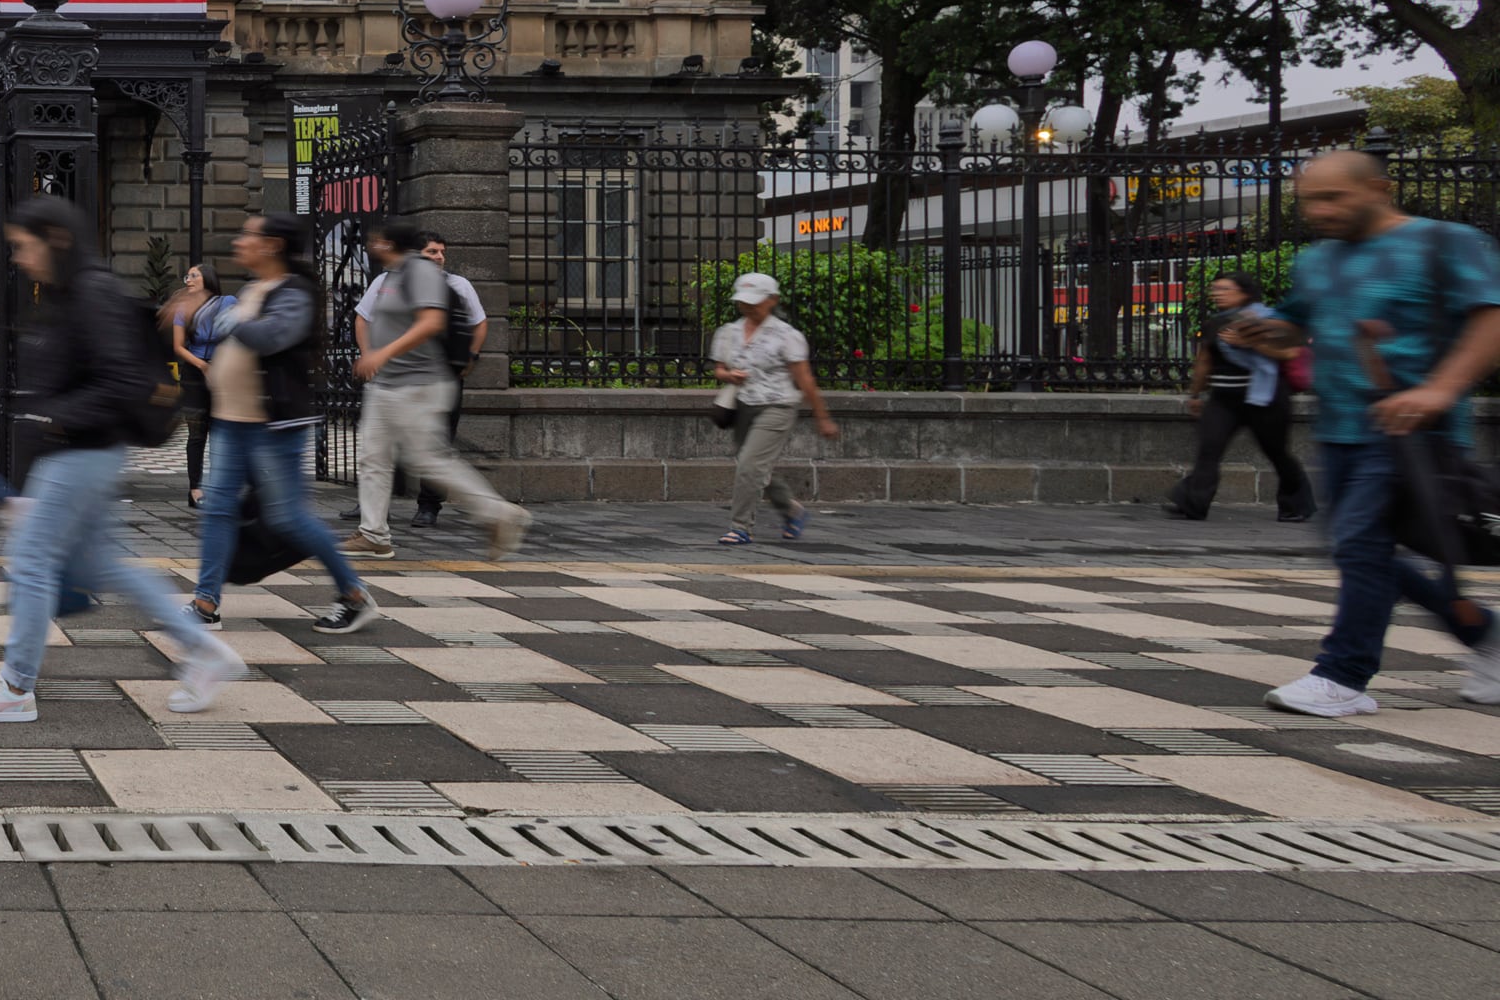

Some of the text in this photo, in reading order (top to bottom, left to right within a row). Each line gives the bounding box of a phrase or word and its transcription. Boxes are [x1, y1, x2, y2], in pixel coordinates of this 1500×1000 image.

[293, 104, 330, 114] Reimaginar
[293, 117, 339, 140] TEATRO
[296, 176, 310, 215] FRANCISCO
[798, 215, 846, 235] DUNKN'
